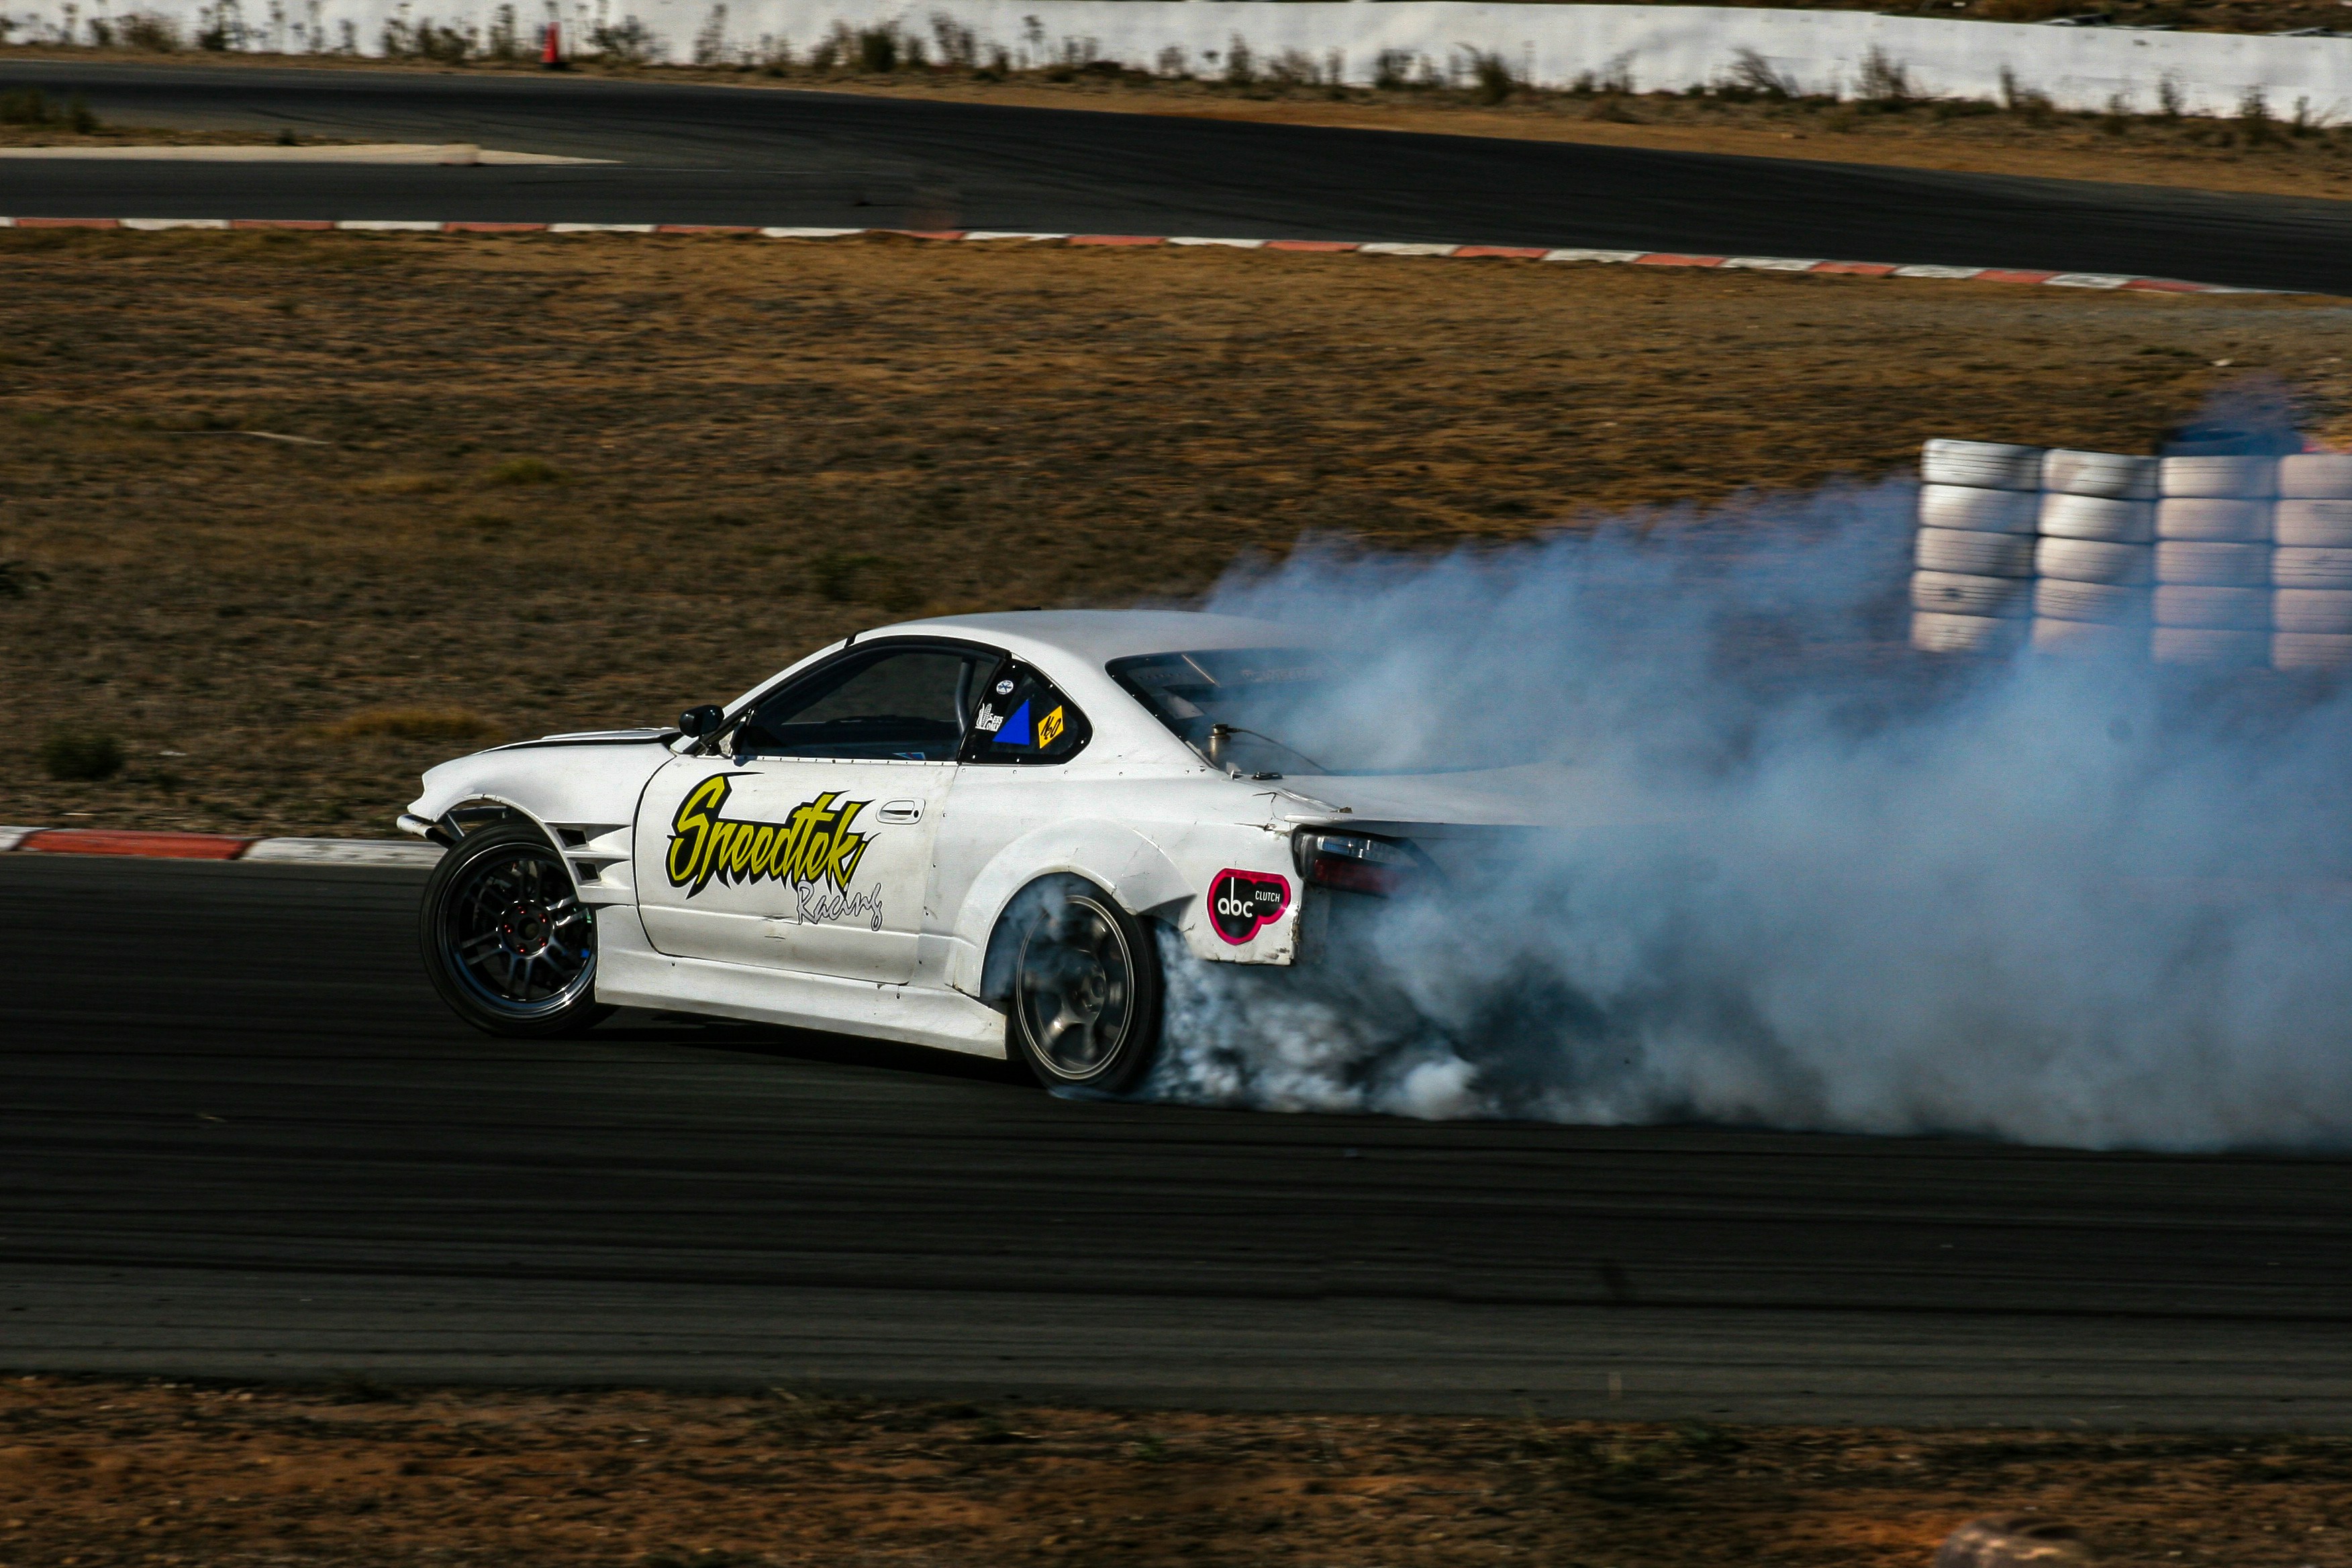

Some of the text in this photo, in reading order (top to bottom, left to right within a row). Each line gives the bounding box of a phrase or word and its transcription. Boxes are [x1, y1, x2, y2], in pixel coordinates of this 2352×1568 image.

[796, 879, 883, 932] Racing
[1218, 877, 1281, 918] abc CLUTCH
